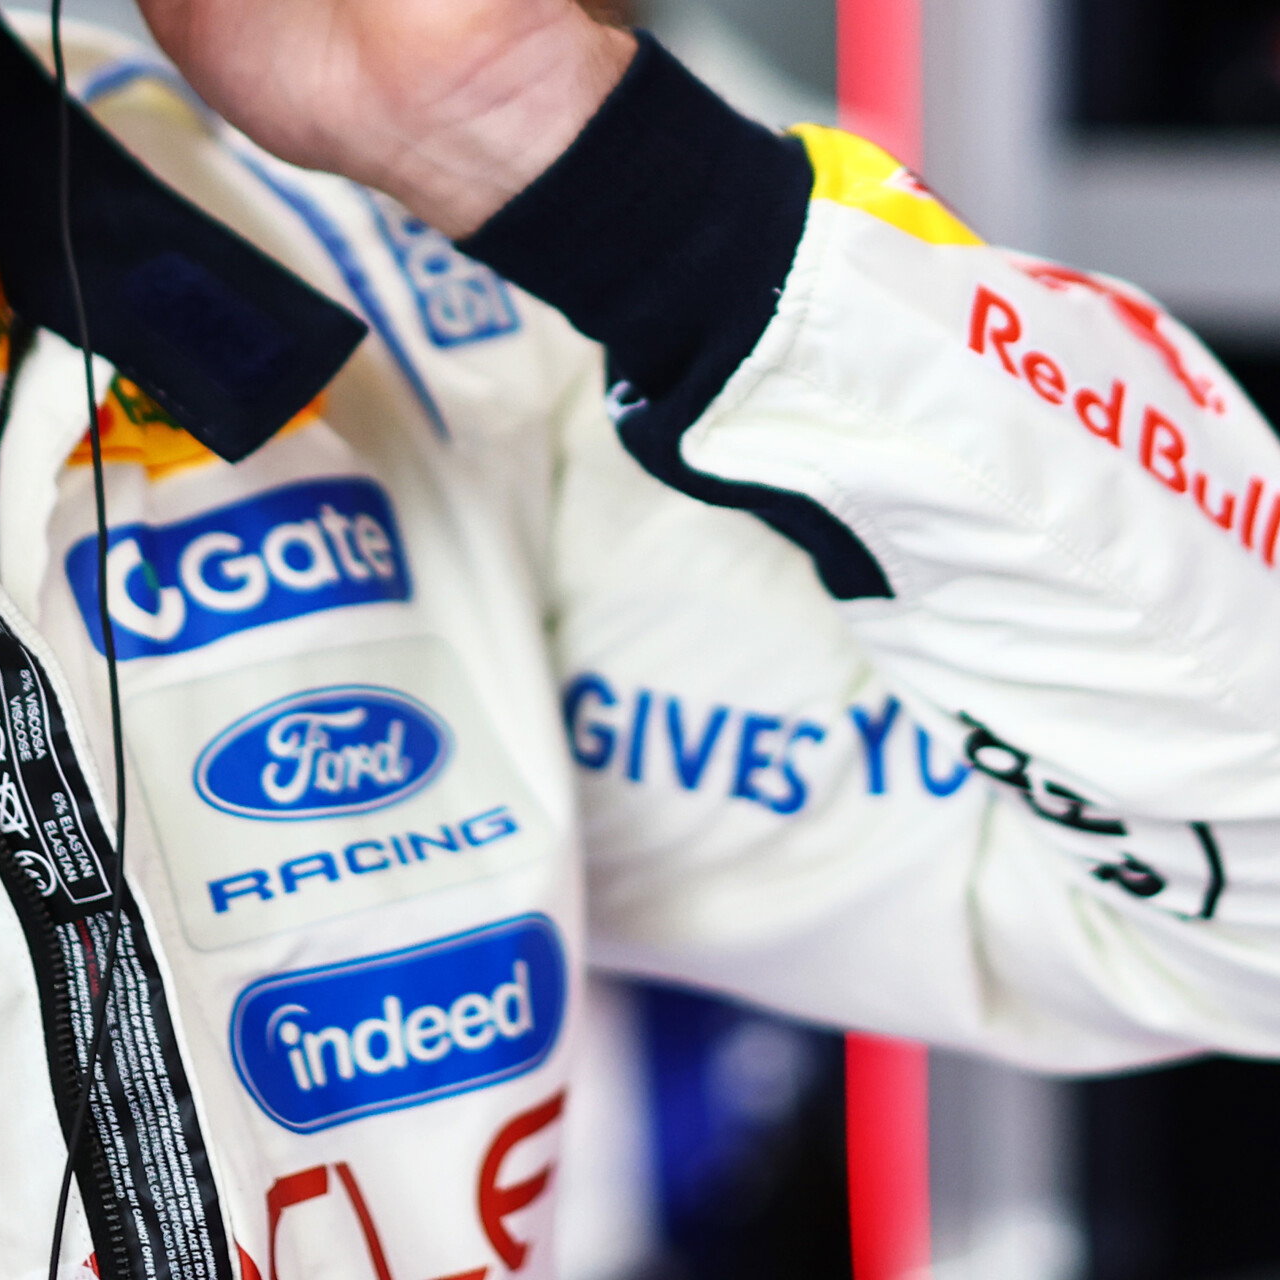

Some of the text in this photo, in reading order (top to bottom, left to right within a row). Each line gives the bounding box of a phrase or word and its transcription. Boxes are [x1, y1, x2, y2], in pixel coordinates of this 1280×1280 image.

[967, 283, 1127, 450] Red
[179, 503, 393, 612] Gate
[9, 694, 33, 762] VISCOSE
[25, 694, 46, 761] VISCOSA
[262, 707, 412, 806] Ford
[562, 673, 827, 815] GIVES
[43, 820, 79, 884] ELASTAN
[59, 813, 96, 879] ELASTAN
[206, 805, 522, 914] RACING
[278, 962, 535, 1093] indeed
[160, 1126, 186, 1195] RECOMMENDED
[175, 1132, 188, 1152] AND
[186, 1176, 206, 1227] EXTREMELY
[150, 1183, 164, 1210] CAPO
[160, 1221, 174, 1249] CASO
[178, 1195, 189, 1209] TO
[181, 1208, 200, 1251] REPLACE
[132, 1207, 149, 1245] CANNOT
[141, 1245, 156, 1275] OFFER
[194, 1261, 205, 1277] DO
